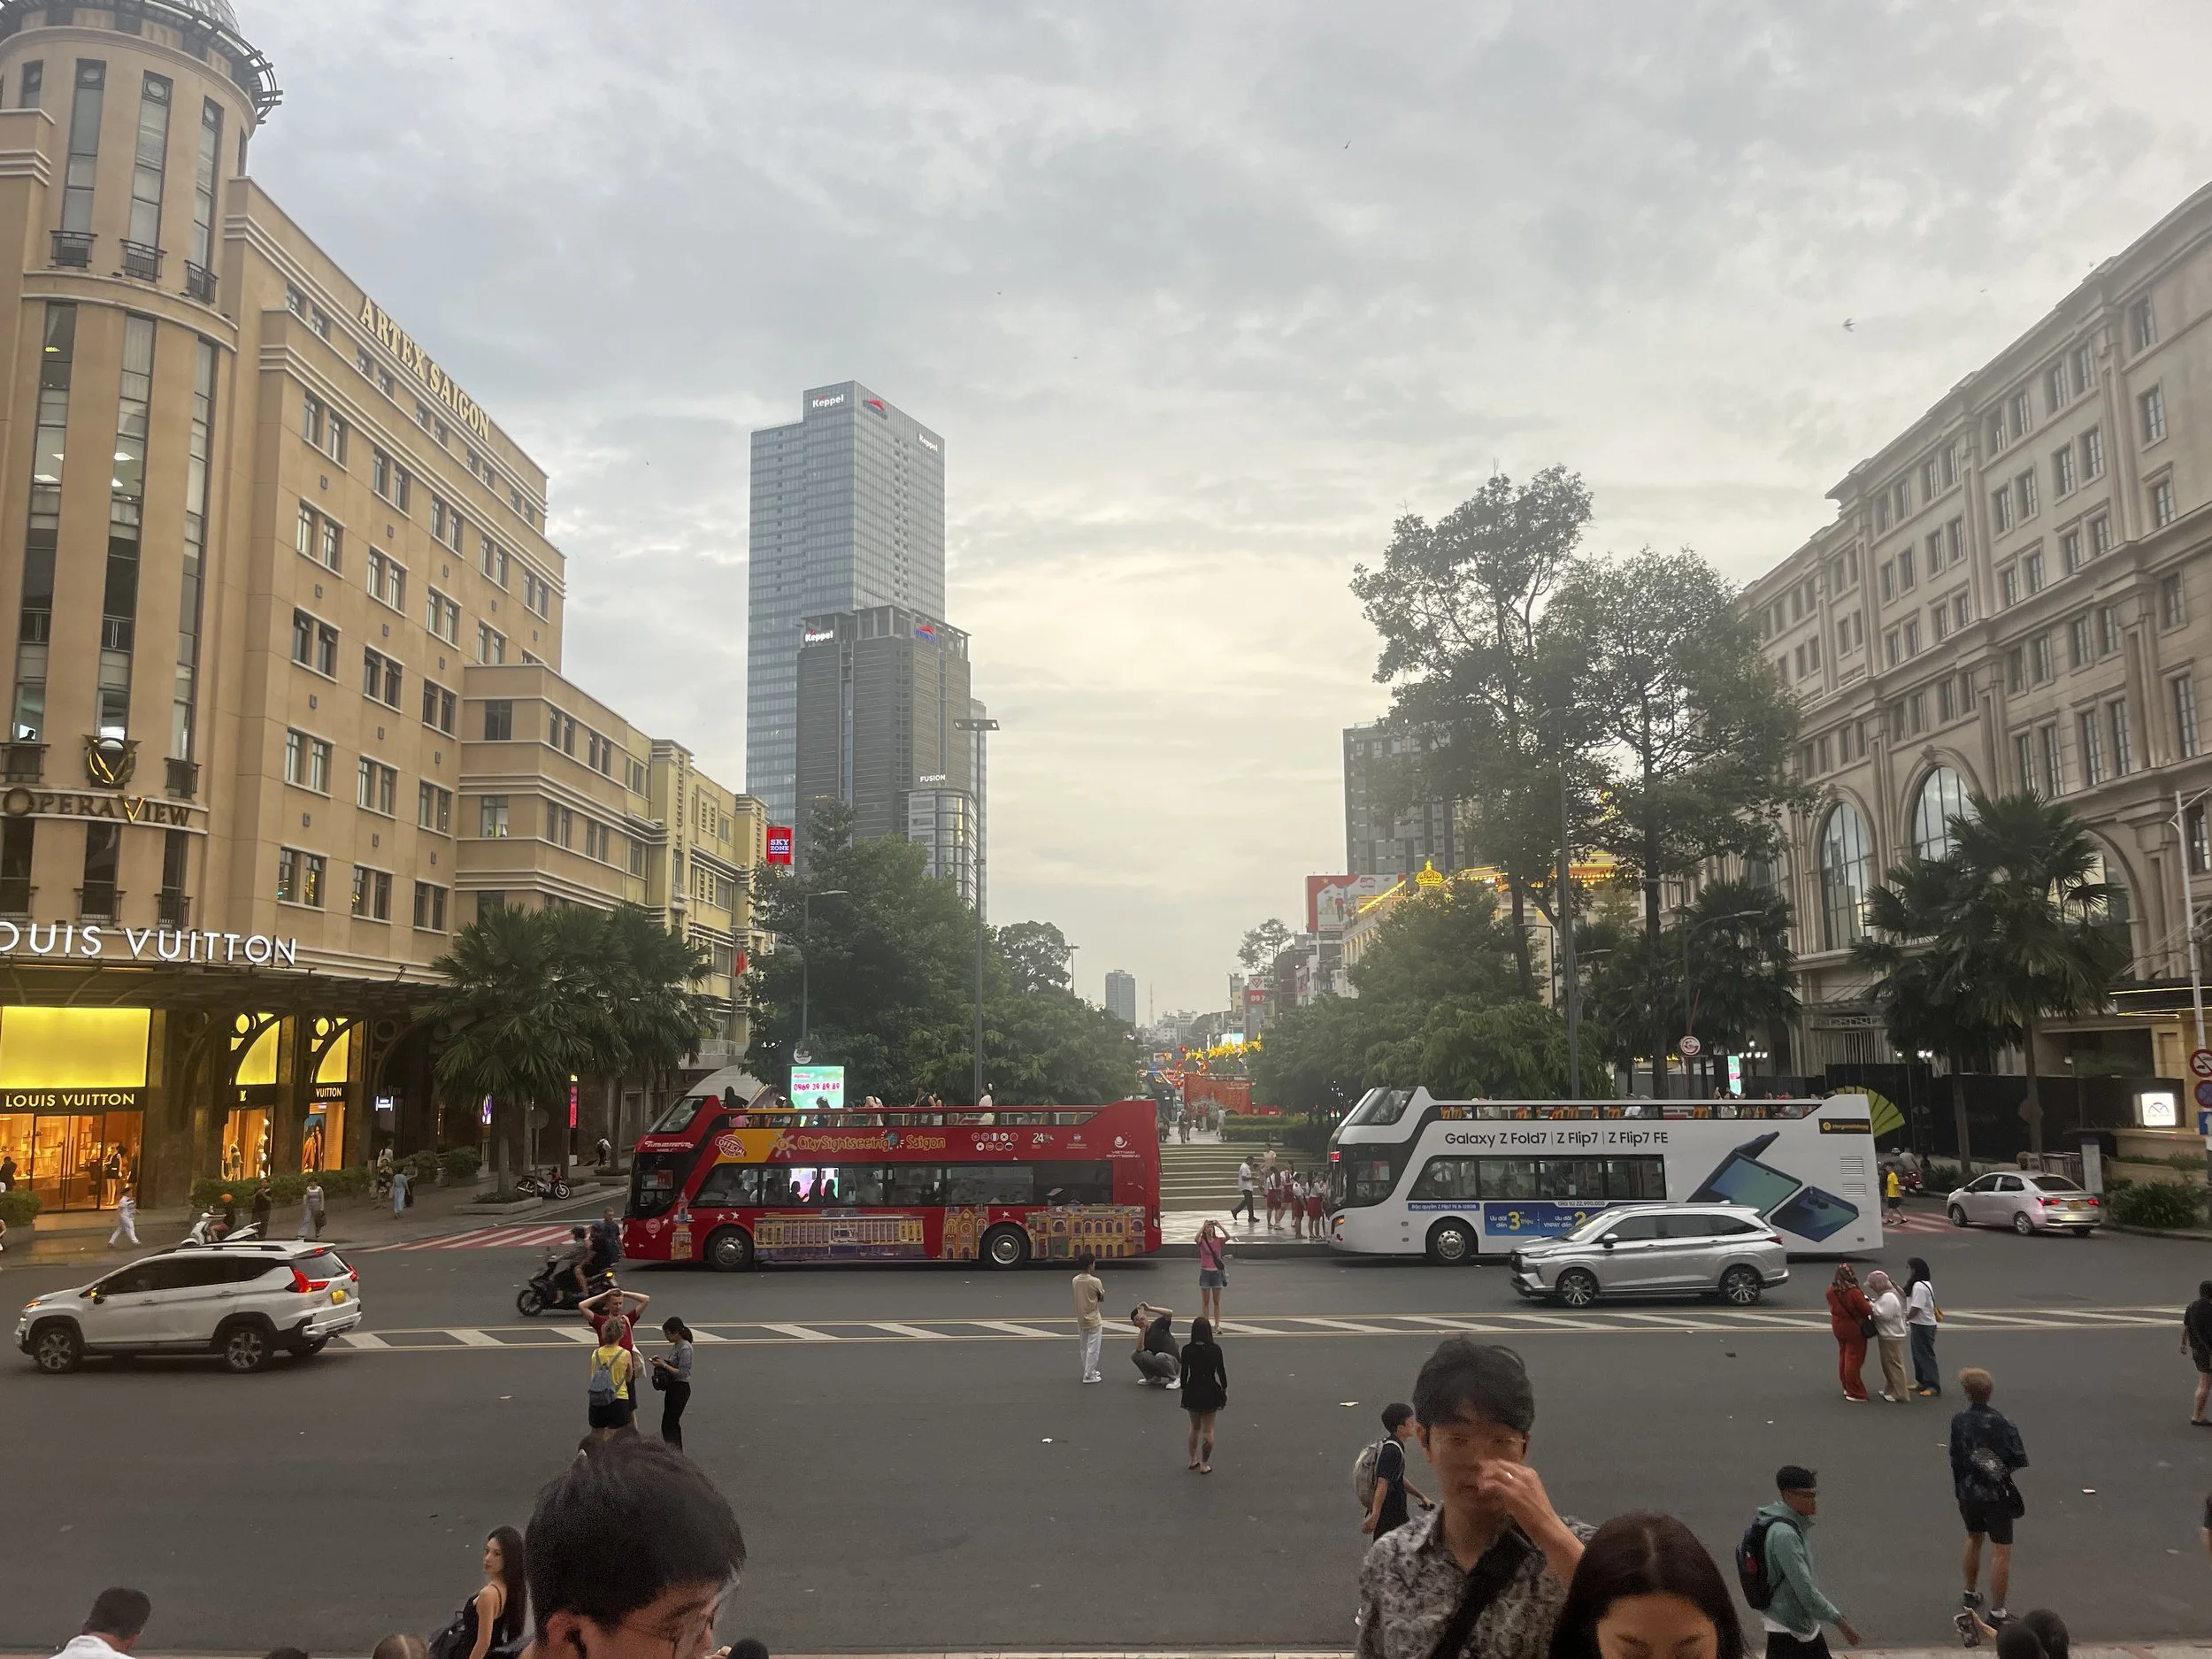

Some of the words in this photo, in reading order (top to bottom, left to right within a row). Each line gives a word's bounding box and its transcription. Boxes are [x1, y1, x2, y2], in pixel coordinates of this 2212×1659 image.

[360, 296, 426, 380] ARTEX
[430, 362, 490, 441] SAIGON
[812, 394, 844, 408] Keppel
[918, 434, 938, 452] Keppel
[805, 630, 833, 642] Keppel
[4, 787, 116, 818] OPERA
[118, 795, 191, 827] VIEW
[124, 926, 297, 967] VUITTON
[5, 1094, 56, 1108] LOUIS
[62, 1093, 135, 1107] VUITTON
[315, 1087, 342, 1098] VUITTON
[905, 1134, 946, 1151] Saigon
[1444, 1133, 1495, 1148] Galaxy
[1500, 1133, 1508, 1144] Z
[1510, 1132, 1547, 1144] Fold7
[1556, 1133, 1565, 1144] Z
[1568, 1132, 1598, 1147] Flip7
[1609, 1133, 1617, 1143] Z
[1619, 1132, 1650, 1147] Flip7
[1653, 1132, 1669, 1143] FE
[1508, 1211, 1520, 1230] 3
